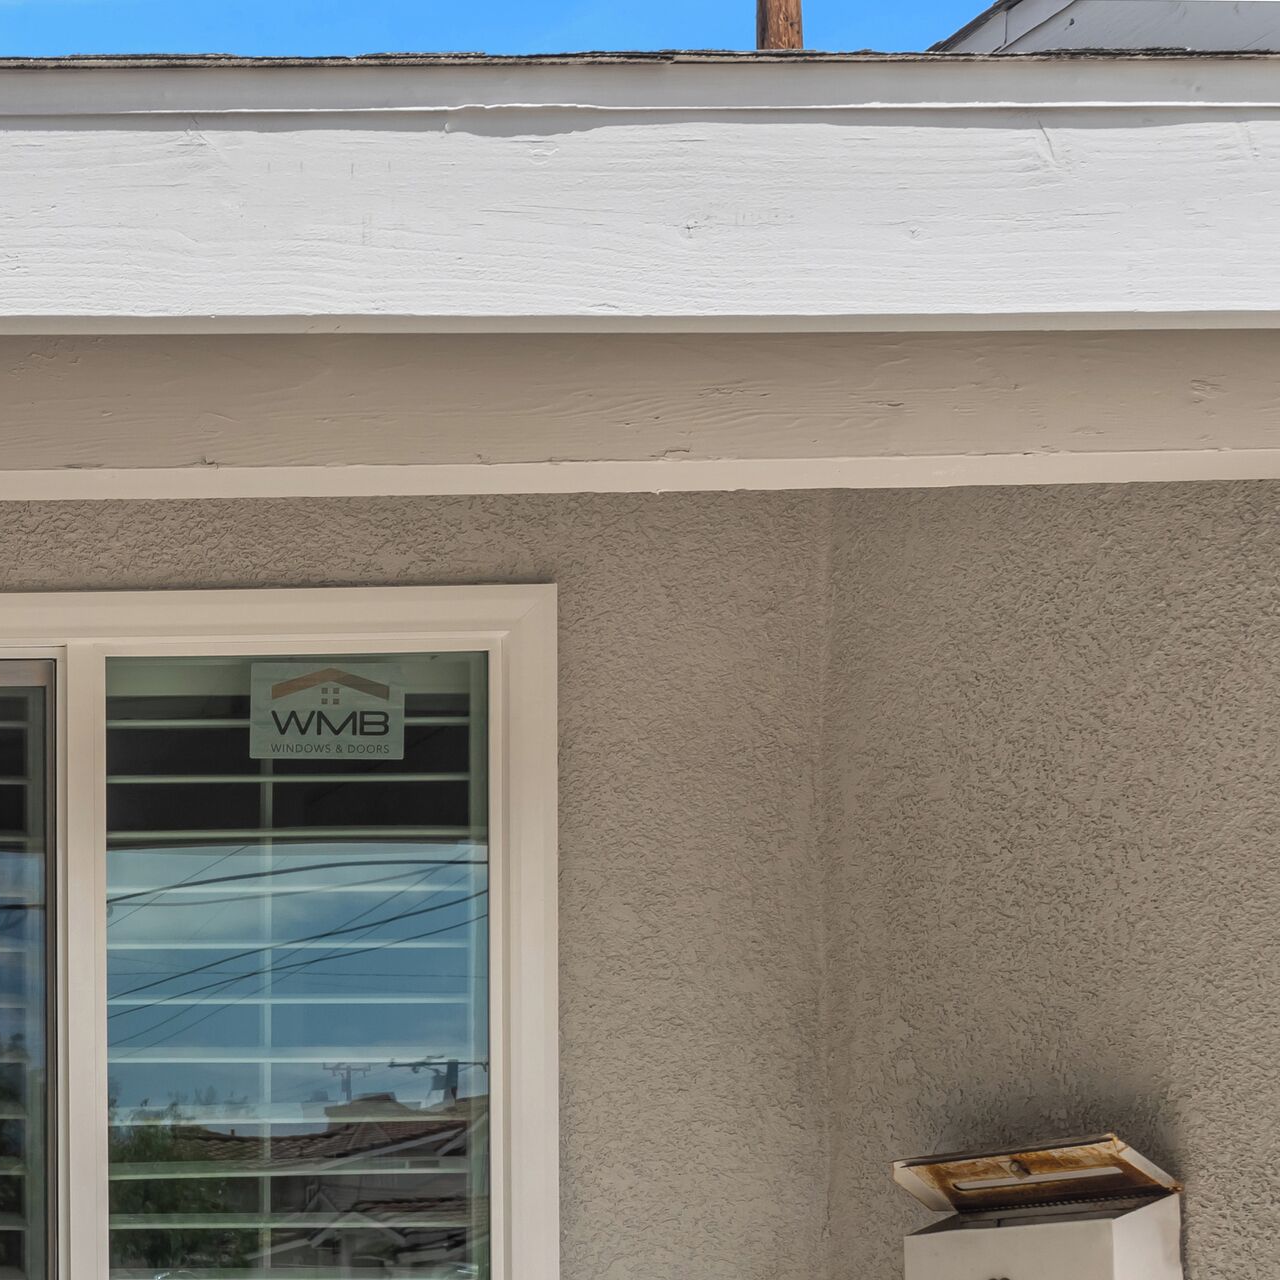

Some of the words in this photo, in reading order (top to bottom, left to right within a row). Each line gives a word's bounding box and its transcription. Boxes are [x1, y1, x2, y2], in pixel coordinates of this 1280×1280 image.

[271, 710, 390, 736] WMB
[271, 743, 331, 754] WINDOWS
[335, 744, 343, 754] &
[347, 744, 390, 754] DOORS
